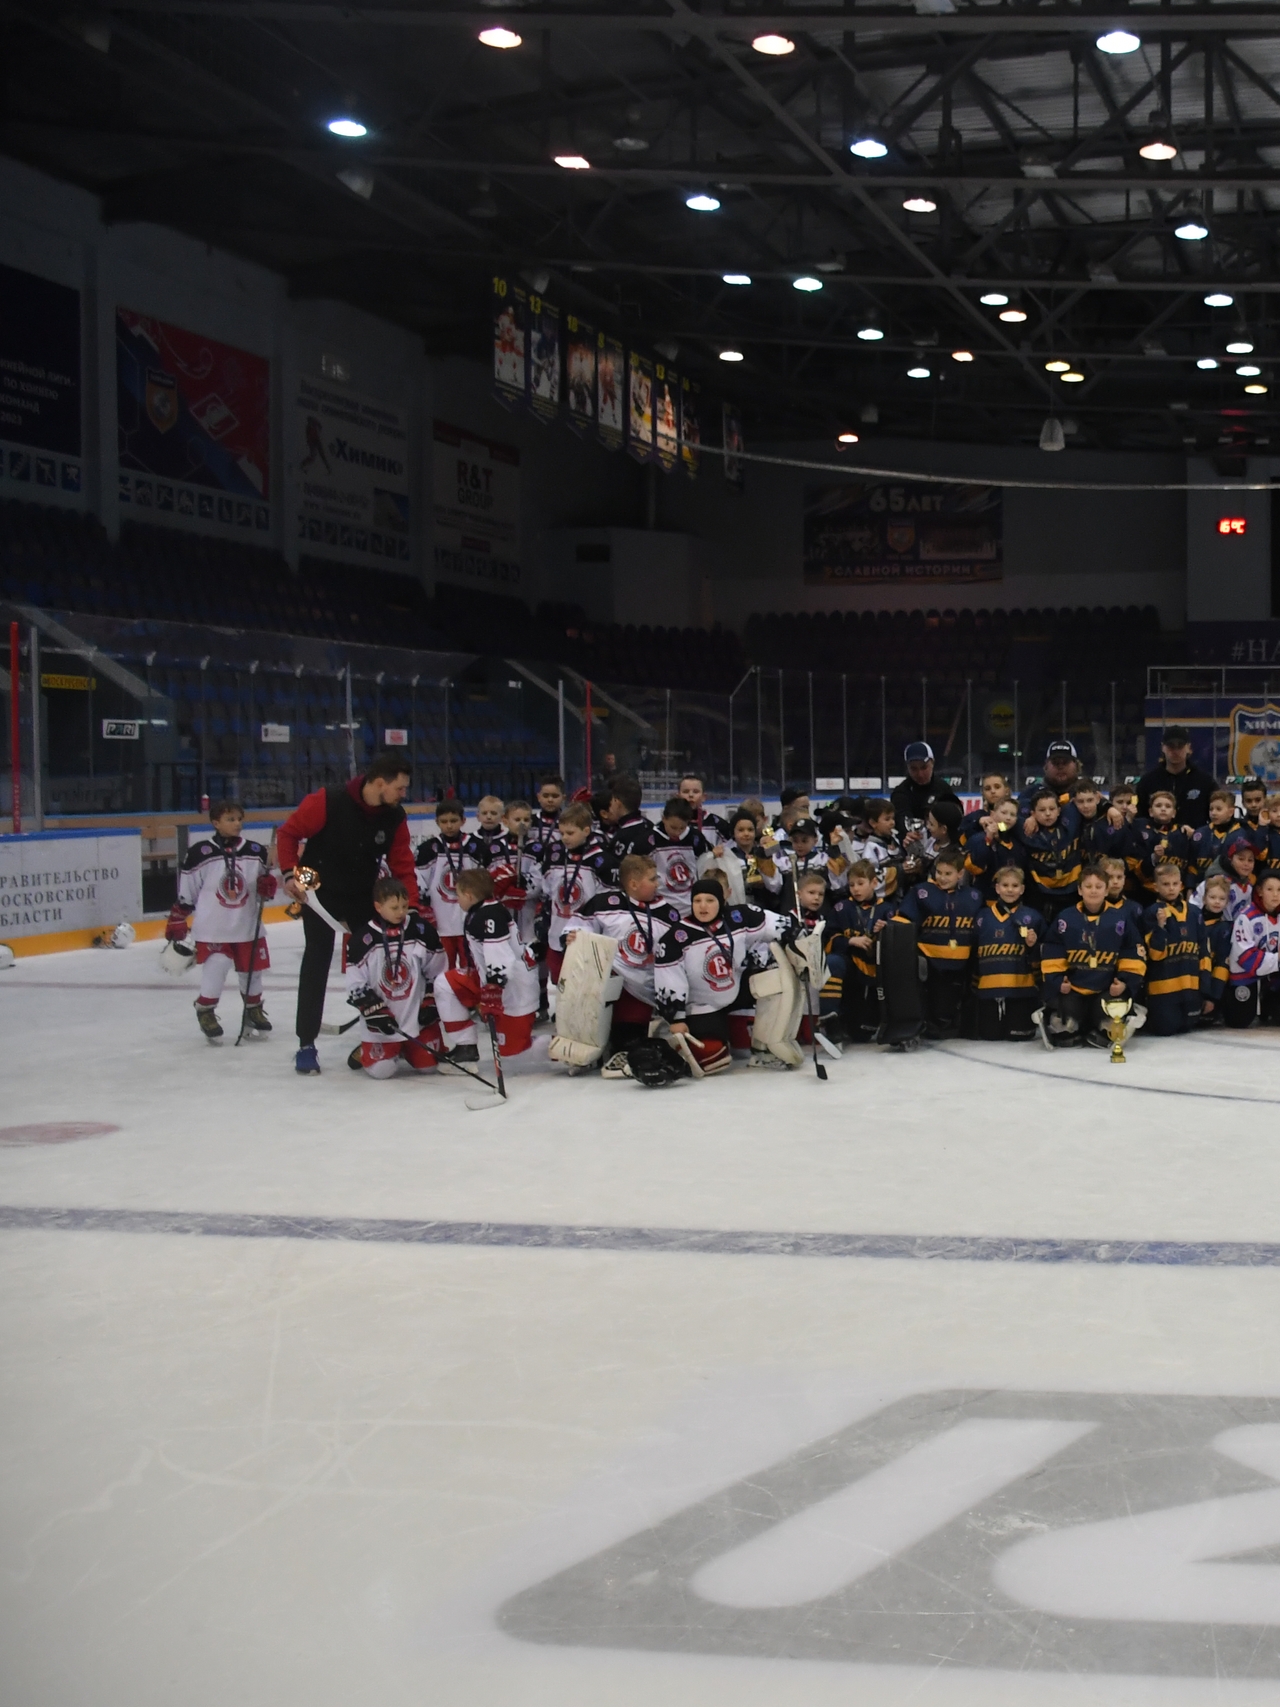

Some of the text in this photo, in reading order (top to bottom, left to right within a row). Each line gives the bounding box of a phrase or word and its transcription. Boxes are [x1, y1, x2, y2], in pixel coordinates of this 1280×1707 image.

[457, 459, 493, 493] R&T
[457, 487, 494, 511] GROUP
[869, 487, 905, 512] 65
[834, 563, 971, 577] СЛАВНОЙ ИСТОРИИ
[1226, 776, 1257, 784] PARI
[0, 867, 120, 889] РАВИТЕЛЬСТВО
[1, 884, 97, 907] ОСКОВСКОЙ
[0, 908, 63, 927] БЛАСТИ
